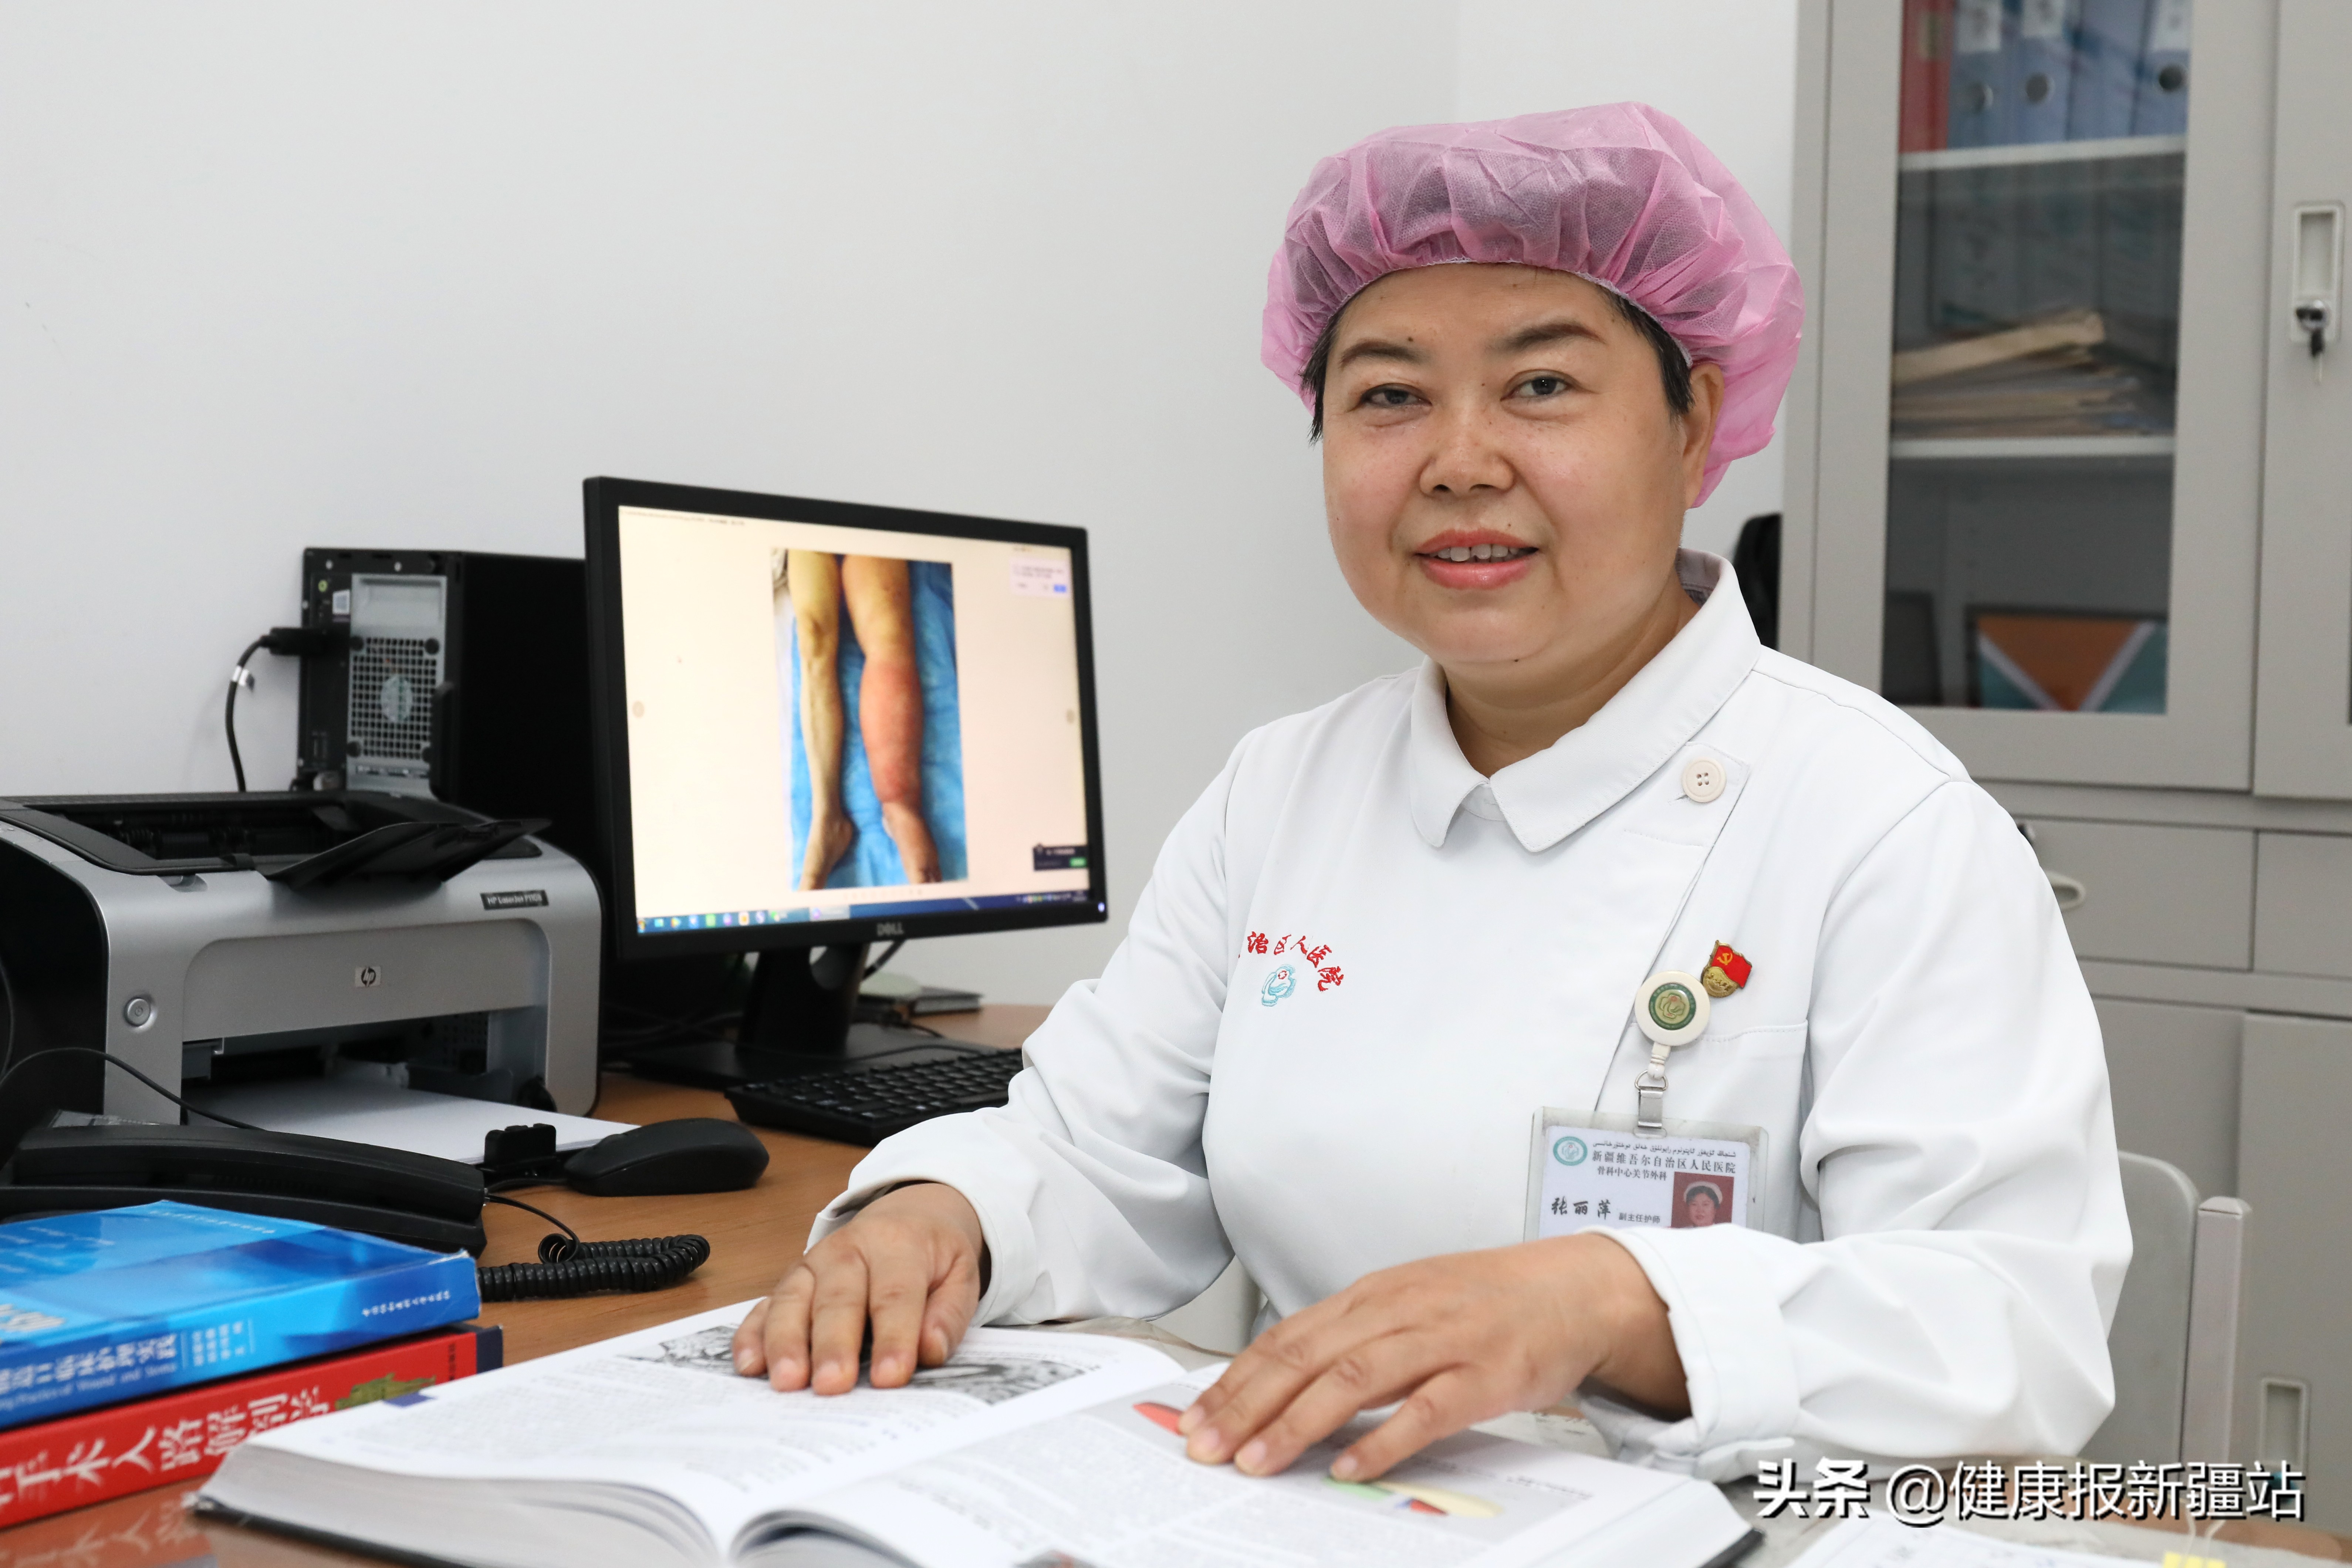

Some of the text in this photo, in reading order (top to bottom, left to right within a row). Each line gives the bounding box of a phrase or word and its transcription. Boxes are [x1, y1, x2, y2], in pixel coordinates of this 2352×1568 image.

[877, 922, 904, 936] DELL
[1592, 1150, 1736, 1174] 新疆维吾尔自治区人民医院
[1598, 1166, 1667, 1181] 骨科中心关节外科
[1551, 1196, 1611, 1220] 张丽萍
[1619, 1212, 1661, 1224] 副主任护师
